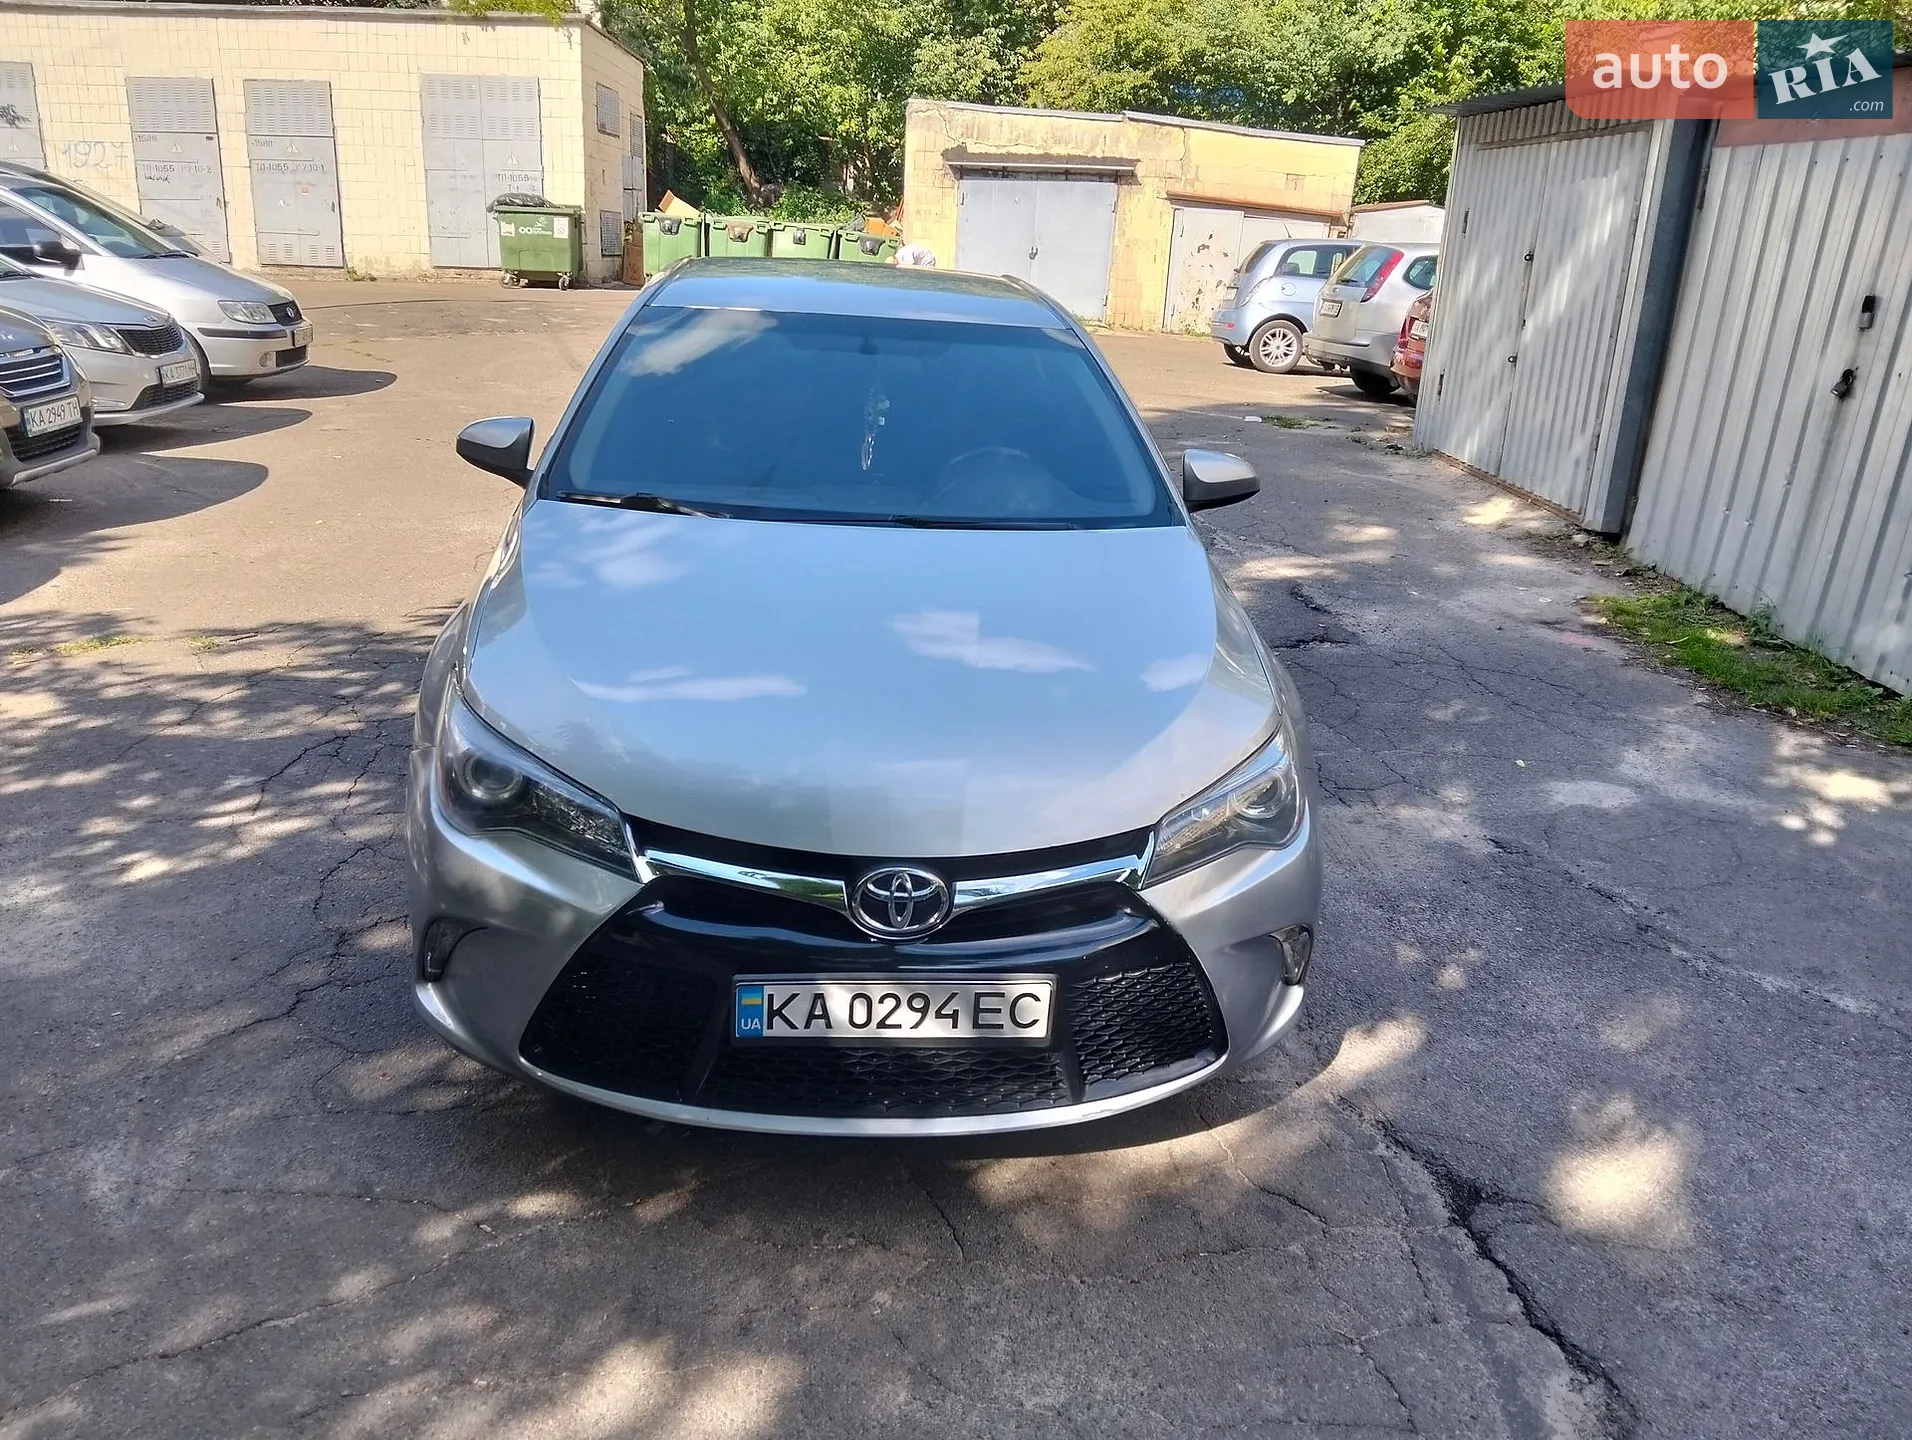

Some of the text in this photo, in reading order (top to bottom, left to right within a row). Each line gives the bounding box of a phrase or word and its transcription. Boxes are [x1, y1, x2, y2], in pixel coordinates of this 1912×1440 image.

[61, 141, 128, 170] 1927
[30, 409, 46, 428] KA
[766, 992, 1041, 1030] KA 0294 EC
[741, 1018, 762, 1030] UA
